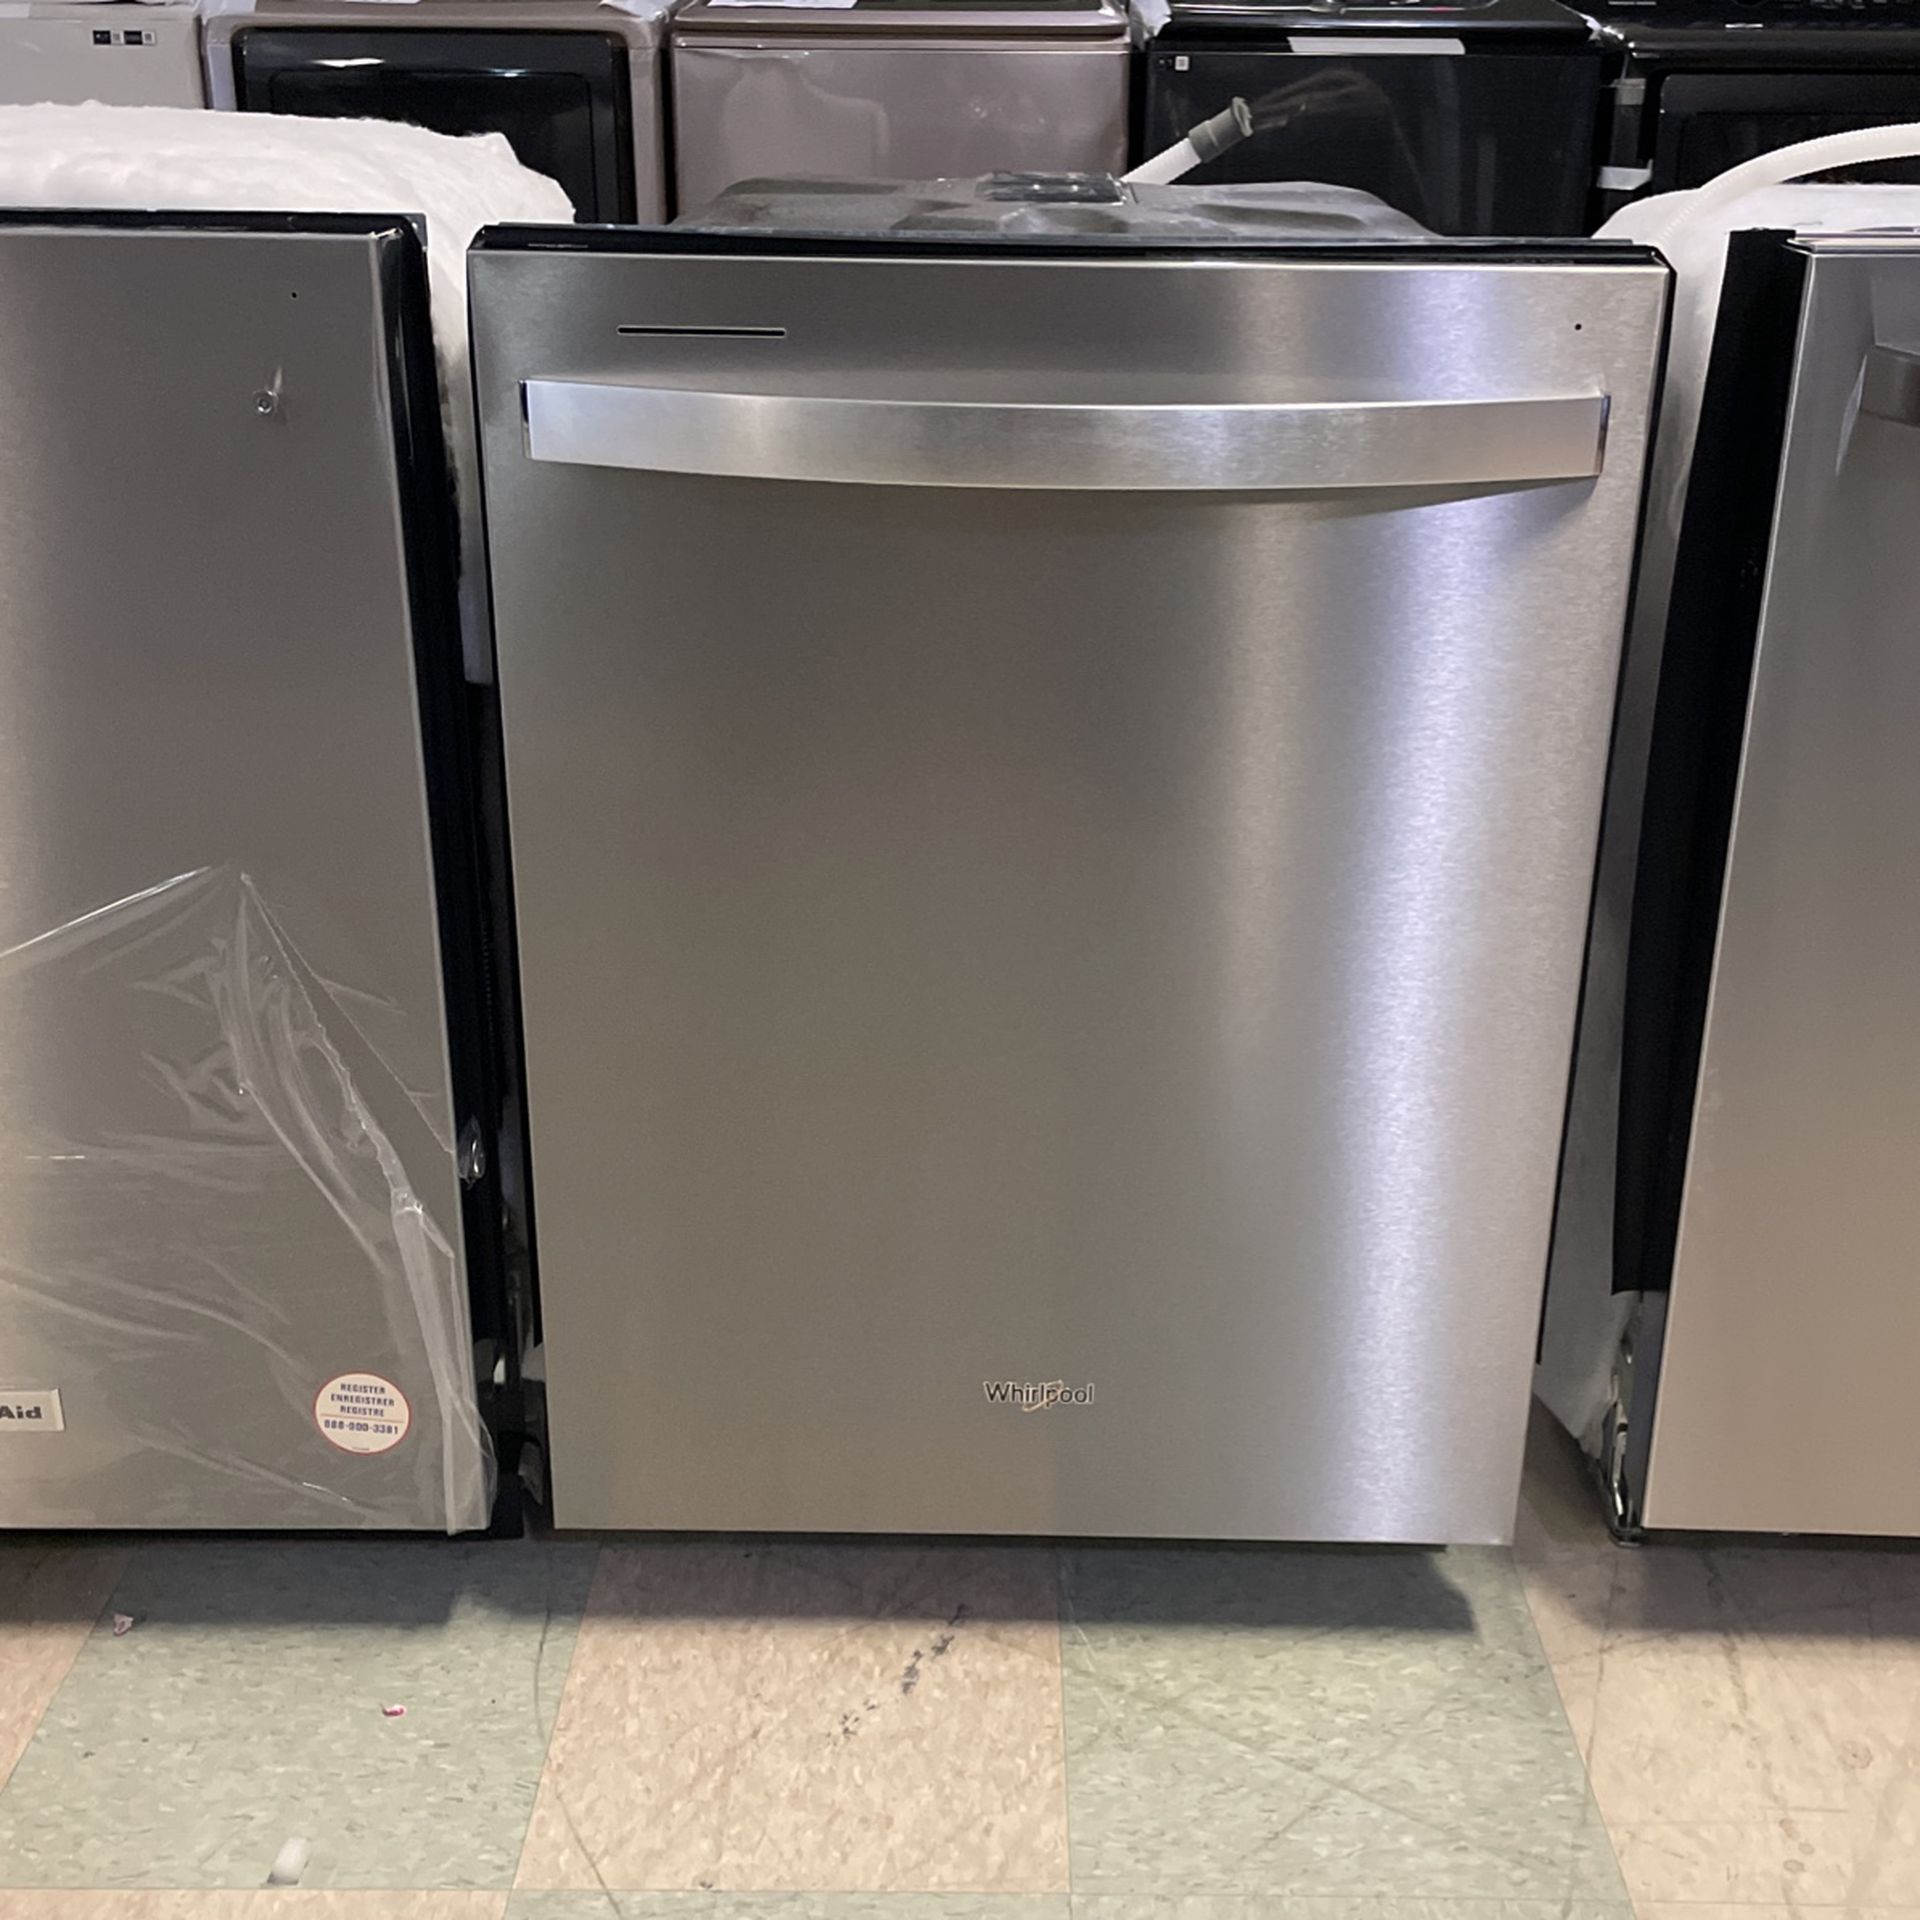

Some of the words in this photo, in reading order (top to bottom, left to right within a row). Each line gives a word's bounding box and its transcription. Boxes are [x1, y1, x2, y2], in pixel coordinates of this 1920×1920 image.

[340, 1383, 385, 1394] REGISTER
[984, 1381, 1094, 1408] Whirlpool
[330, 1394, 394, 1406] ENREGISTRER
[340, 1405, 384, 1417] REGISTRE
